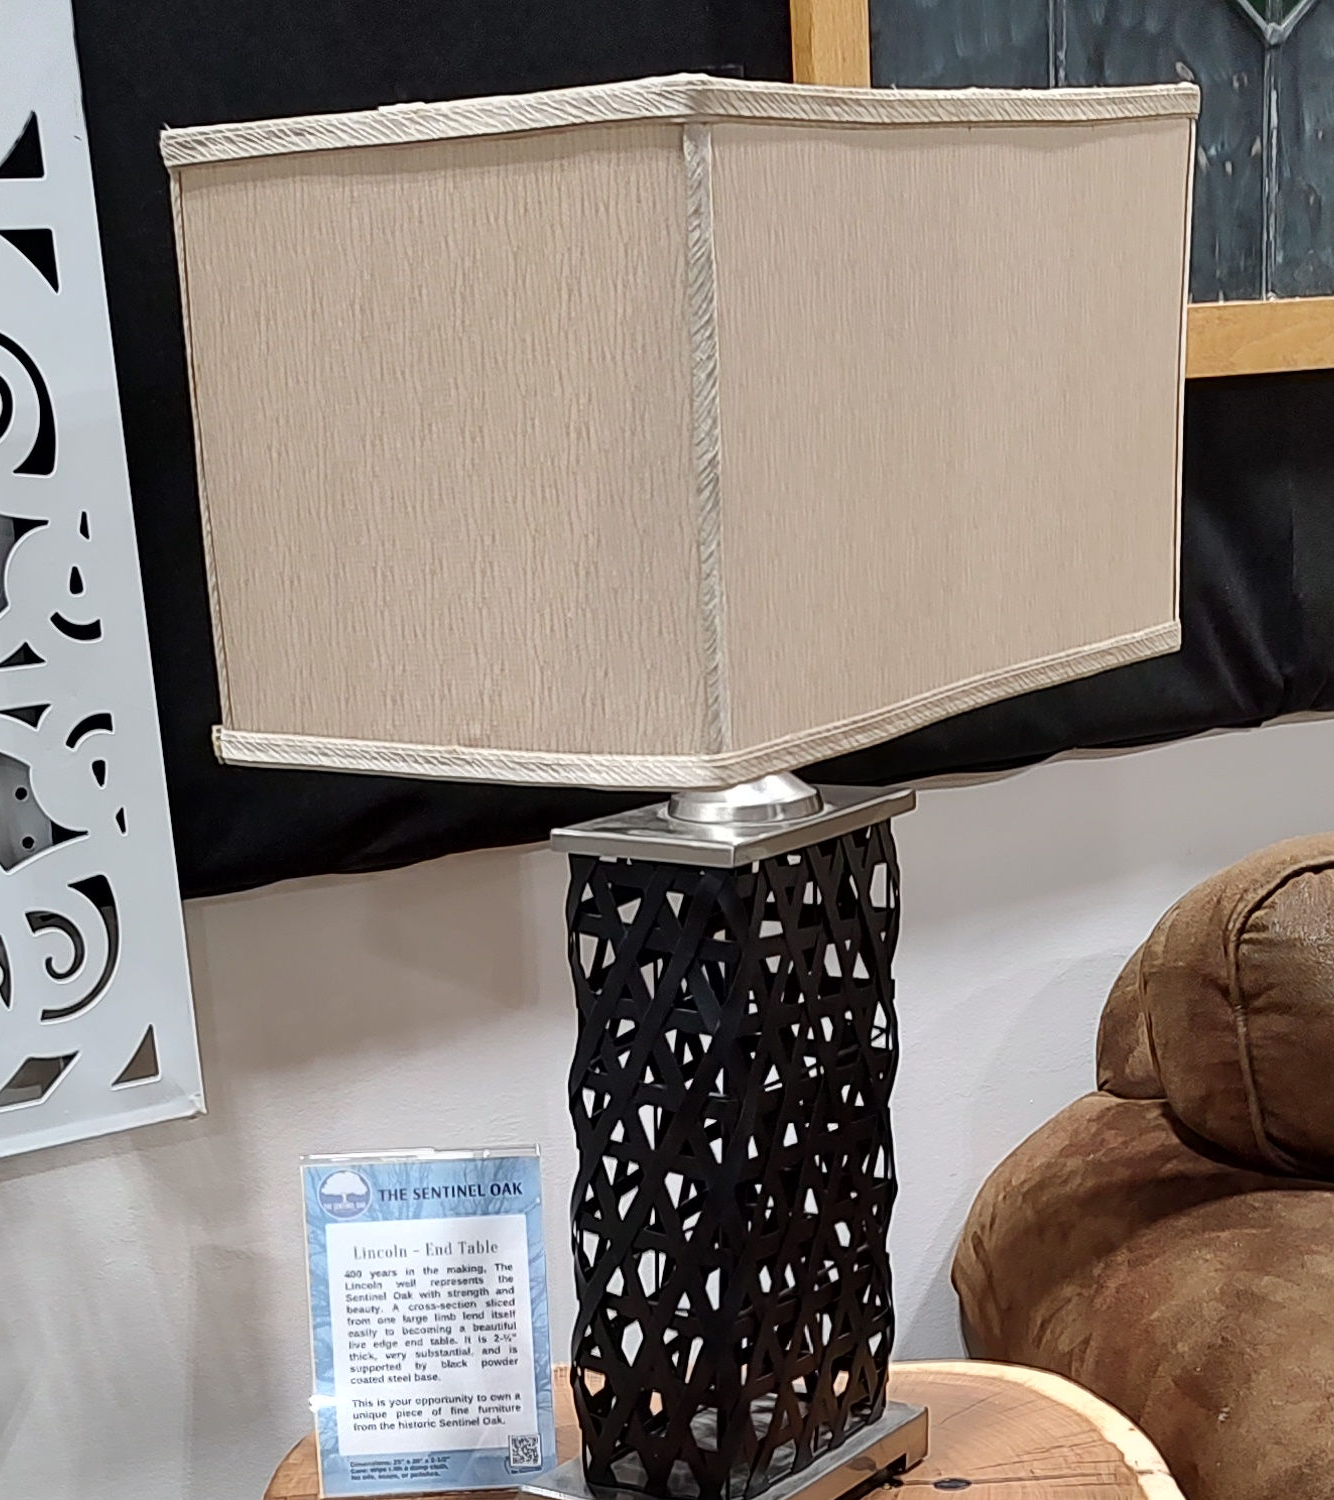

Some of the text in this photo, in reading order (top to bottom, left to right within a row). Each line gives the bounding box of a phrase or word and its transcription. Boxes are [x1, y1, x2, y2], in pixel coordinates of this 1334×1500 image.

[379, 1182, 523, 1202] THE SENTINEL OAK
[353, 1245, 407, 1260] Lincoln
[426, 1242, 452, 1256] End
[458, 1240, 498, 1255] Table
[370, 1269, 397, 1279] years
[423, 1267, 439, 1275] the
[495, 1264, 513, 1272] The
[345, 1282, 383, 1290] Lincoln
[396, 1280, 416, 1288] well
[430, 1278, 484, 1287] represents
[345, 1293, 387, 1302] Sentinel
[393, 1292, 413, 1300] Oak
[448, 1289, 489, 1298] strength
[496, 1287, 515, 1295] and
[346, 1305, 383, 1314] beauty.
[408, 1301, 477, 1311] cross-section
[486, 1298, 515, 1307] sliced
[347, 1317, 370, 1325] from
[403, 1315, 428, 1324] large
[435, 1313, 456, 1321] limb
[491, 1310, 516, 1319] itself
[348, 1329, 377, 1339] easily
[385, 1328, 395, 1336] to
[402, 1325, 452, 1336] becoming
[473, 1322, 517, 1332] beautiful
[349, 1341, 366, 1349] live
[373, 1339, 398, 1349] edge
[405, 1338, 423, 1346] end
[430, 1336, 458, 1345] table.
[478, 1335, 487, 1343] is
[385, 1351, 407, 1360] very
[350, 1357, 519, 1373] supported by black powder
[350, 1373, 440, 1384] coated steel base.
[352, 1399, 373, 1408] This
[377, 1398, 386, 1406] is
[389, 1398, 411, 1408] your
[415, 1394, 474, 1406] opportunity
[477, 1394, 487, 1402] to
[490, 1394, 511, 1402] own
[353, 1404, 521, 1420] unique piece of fine furniture
[353, 1416, 505, 1432] from the historic Sentinel Oak.
